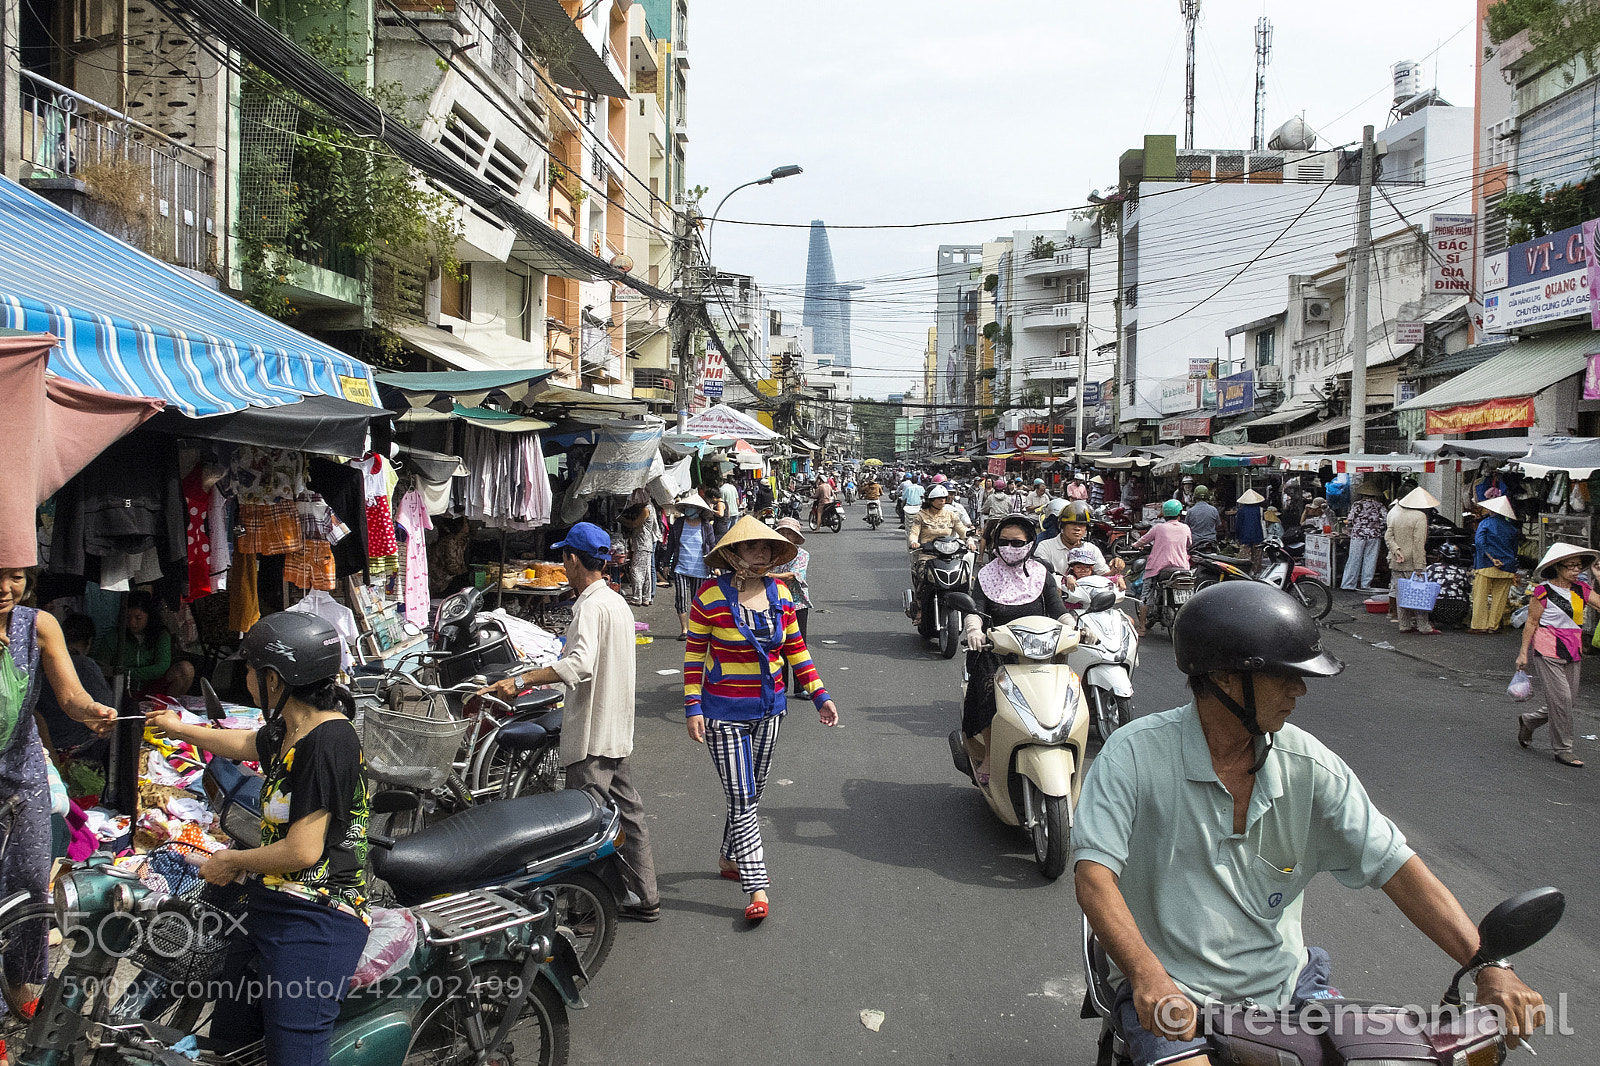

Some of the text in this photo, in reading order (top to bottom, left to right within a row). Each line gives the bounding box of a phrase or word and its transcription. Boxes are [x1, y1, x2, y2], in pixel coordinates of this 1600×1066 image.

[1435, 224, 1453, 235] PHÒNG
[1438, 239, 1468, 250] BÁC
[1446, 252, 1460, 264] SĨ
[1441, 268, 1464, 277] GIA
[1434, 278, 1470, 289] ĐÌNH
[1485, 277, 1505, 287] VT-GAS
[1545, 277, 1576, 299] QUANG
[1515, 305, 1540, 317] CHUYÊN
[1541, 302, 1560, 312] CUNG
[1560, 295, 1574, 307] CẤP
[1576, 293, 1590, 304] GAS
[705, 368, 724, 379] NA
